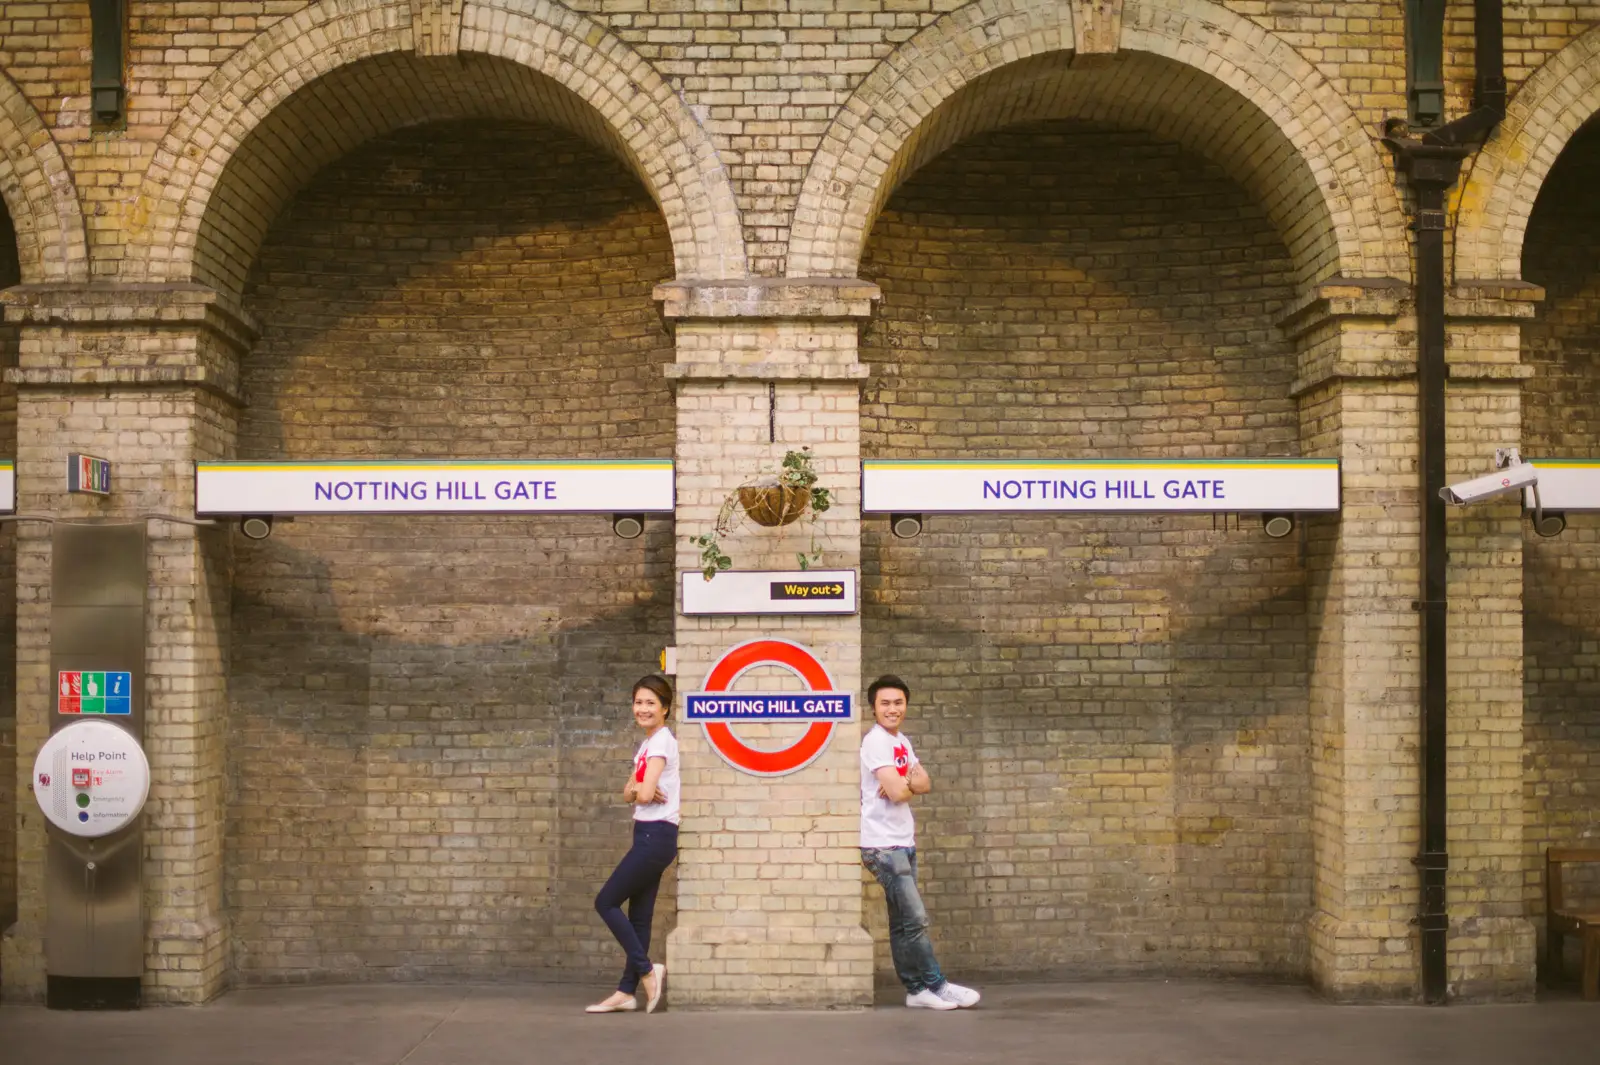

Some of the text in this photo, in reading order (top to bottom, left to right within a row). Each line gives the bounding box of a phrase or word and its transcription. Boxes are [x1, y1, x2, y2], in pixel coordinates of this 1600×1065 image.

[314, 481, 557, 501] NOTTING HILL GATE
[982, 480, 1226, 500] NOTTING HILL GATE
[784, 584, 831, 597] Way out
[693, 700, 844, 714] NOTTING HILL GATE
[71, 751, 127, 763] Help Point
